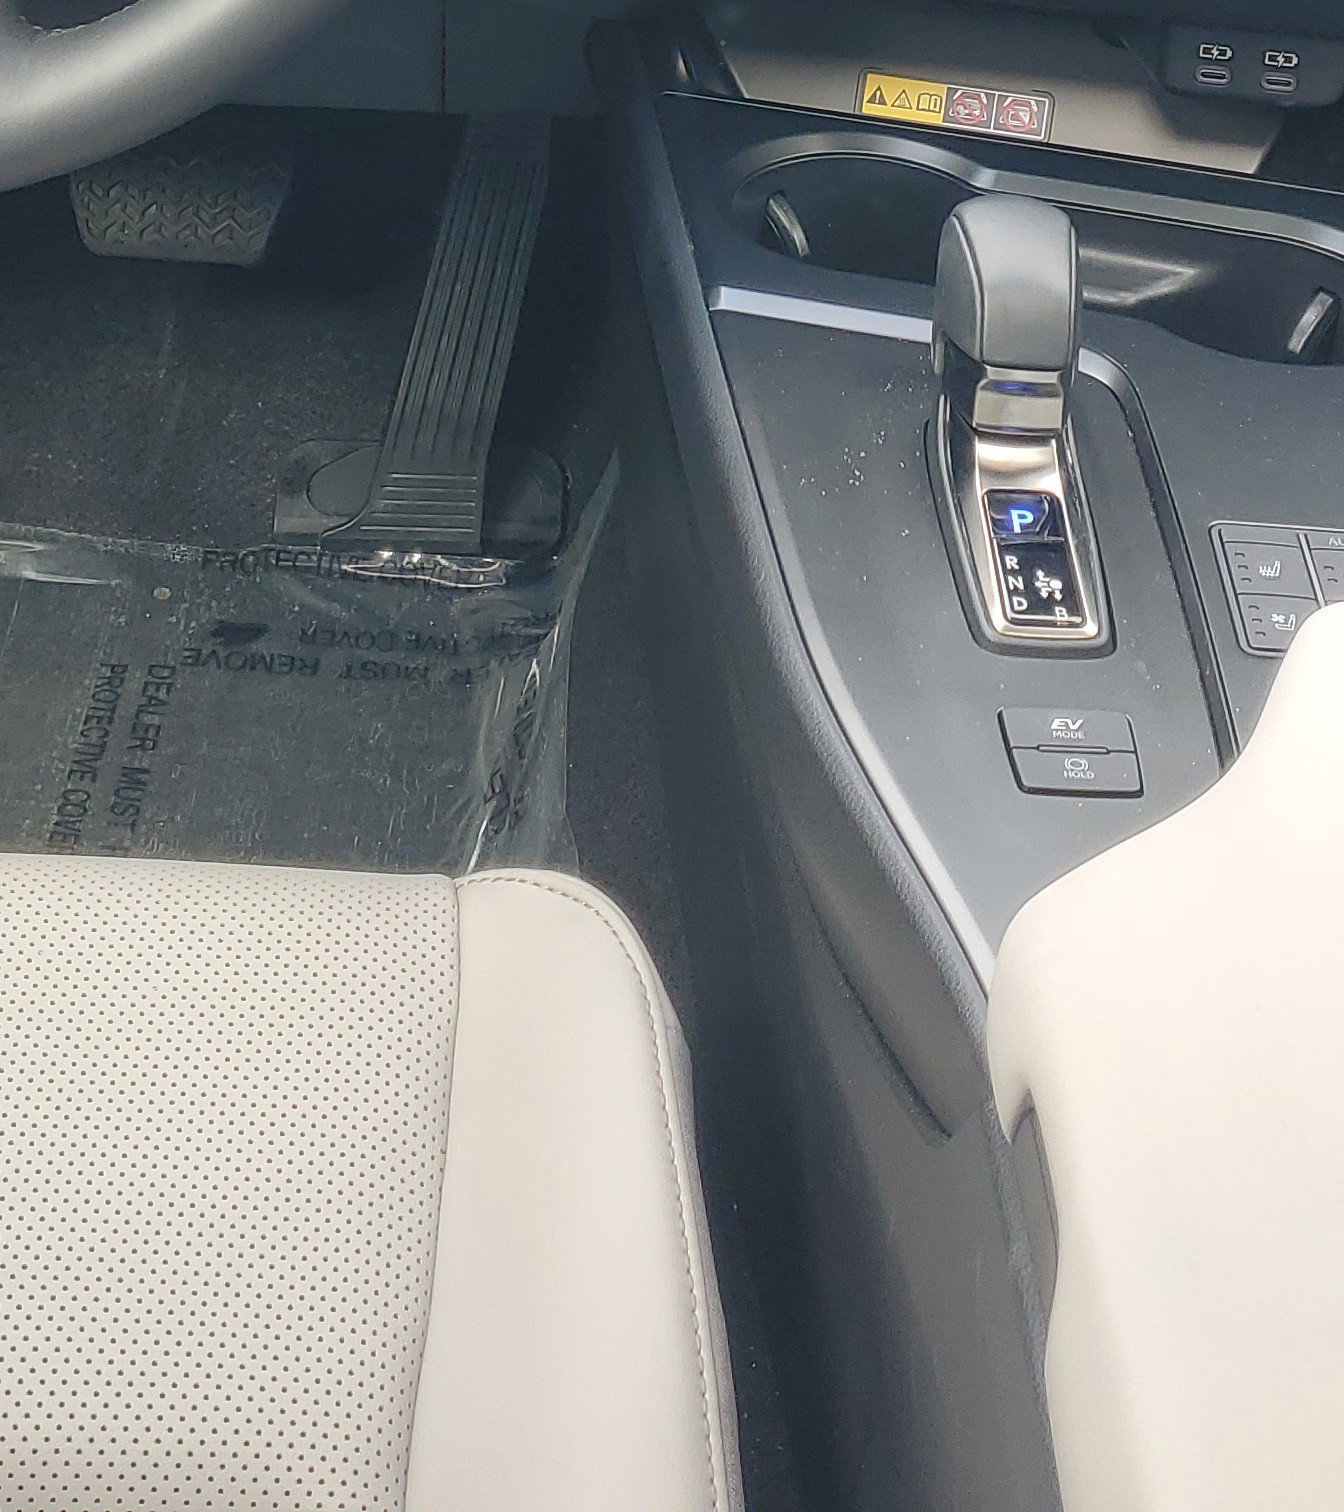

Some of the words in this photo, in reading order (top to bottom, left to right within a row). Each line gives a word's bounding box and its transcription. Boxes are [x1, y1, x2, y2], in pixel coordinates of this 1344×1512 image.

[1010, 508, 1034, 534] P
[1004, 555, 1020, 570] R
[1007, 575, 1025, 591] N
[1012, 596, 1028, 611] D
[1054, 606, 1069, 622] B
[178, 647, 319, 678] REMOVE
[339, 659, 430, 686] MUST
[126, 664, 177, 753] DEALER
[67, 662, 130, 785] PROTECTIVE
[1050, 717, 1085, 730] EV
[1052, 729, 1085, 740] MODE
[1063, 769, 1095, 780] HOLD
[107, 766, 153, 836] MUST
